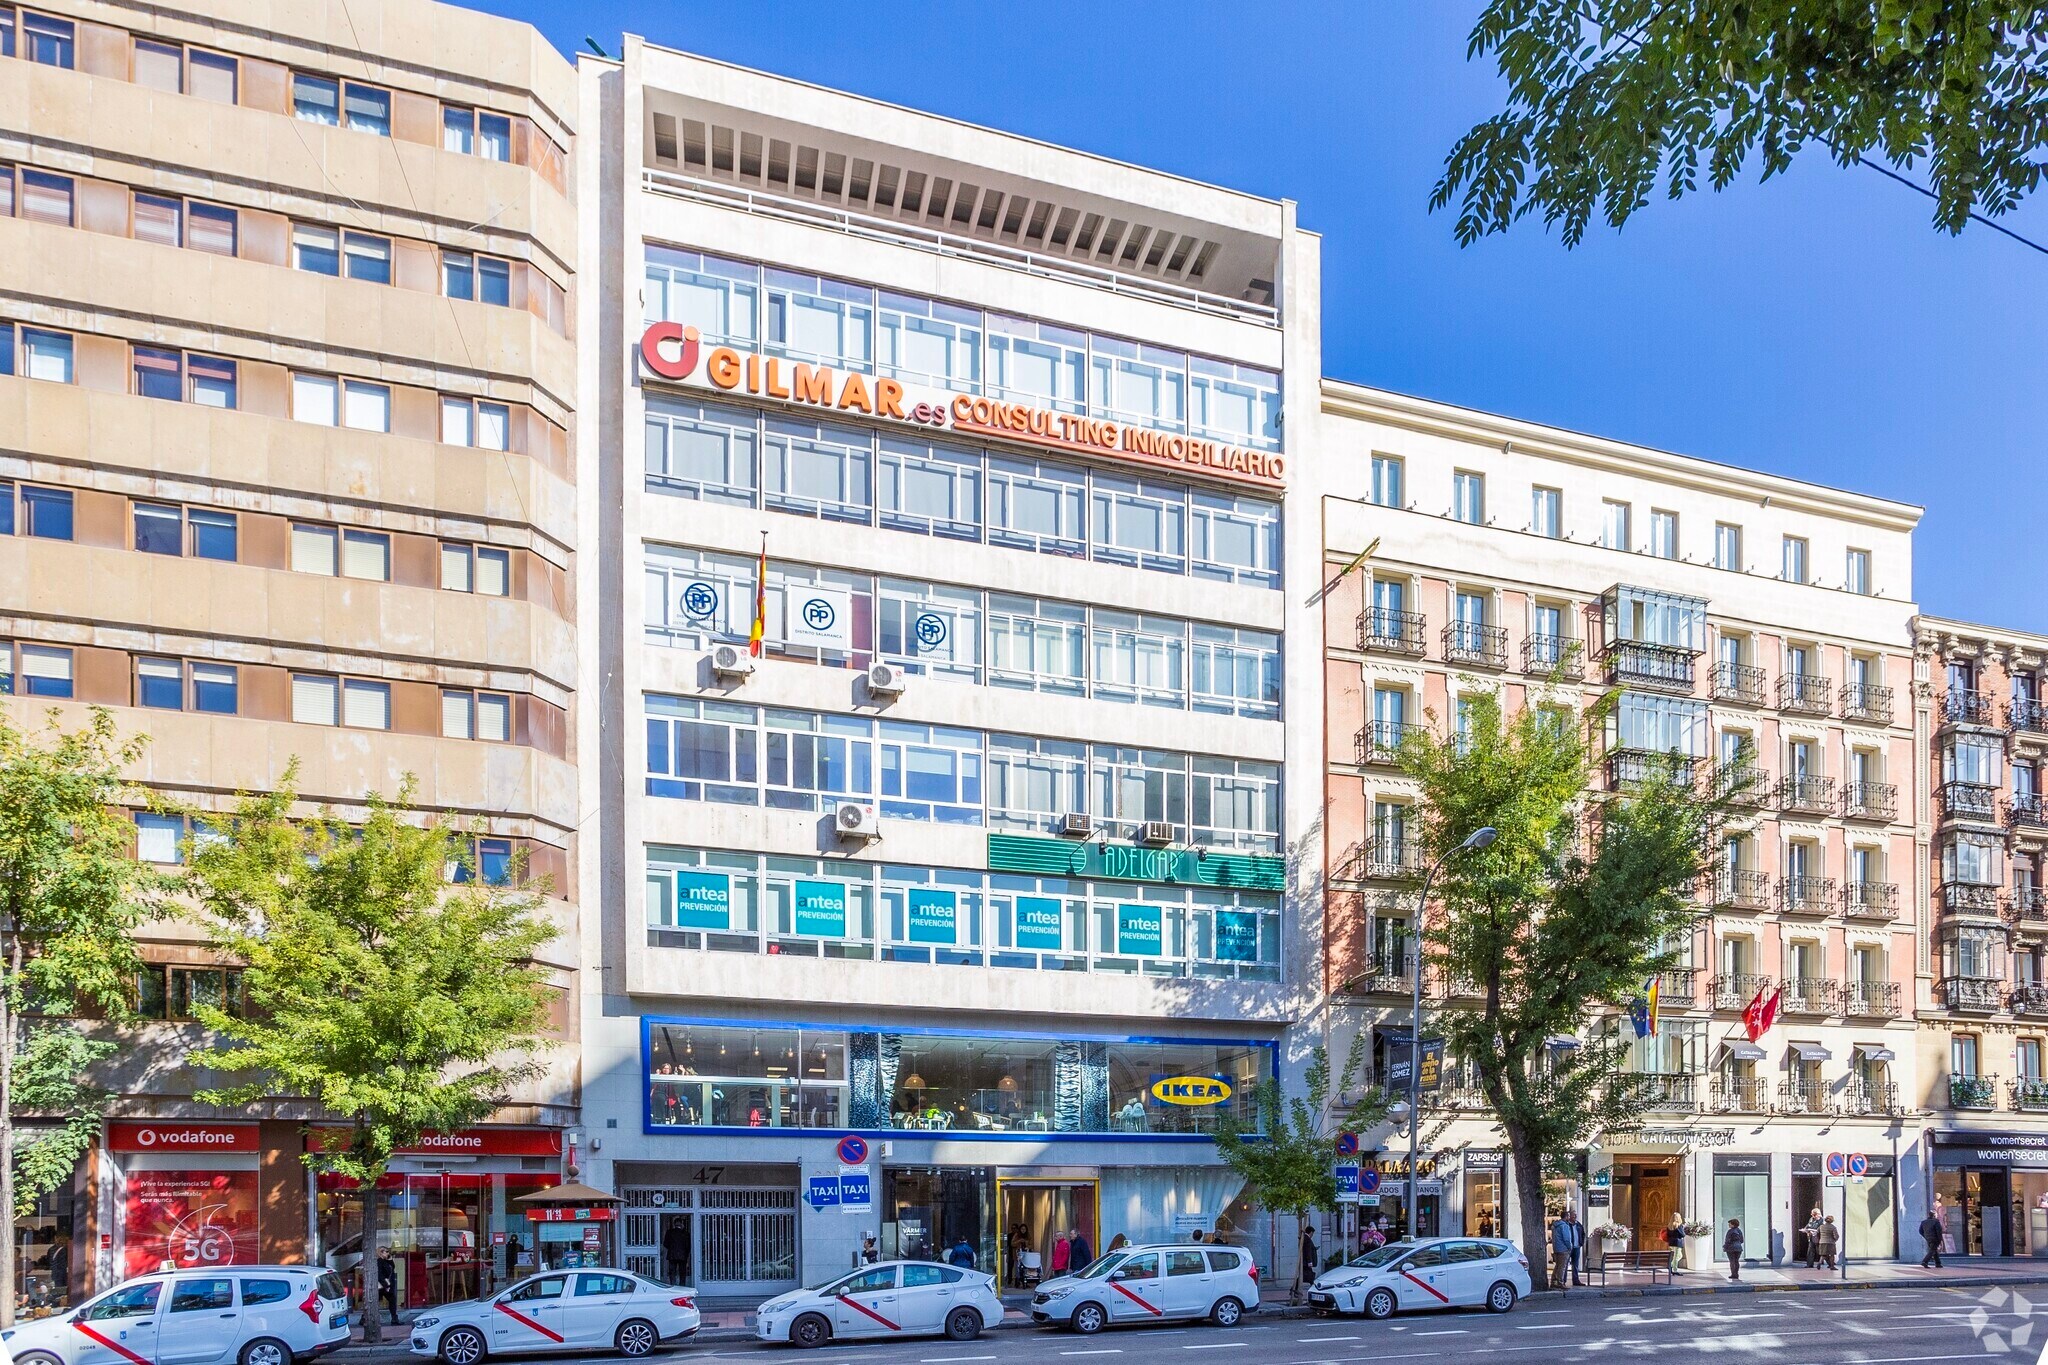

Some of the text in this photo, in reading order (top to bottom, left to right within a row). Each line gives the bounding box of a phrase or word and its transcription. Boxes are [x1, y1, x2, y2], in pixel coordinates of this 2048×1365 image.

[951, 394, 1287, 480] CONSULTING INMOBILIARIO
[692, 592, 712, 608] PP
[809, 608, 829, 624] PP
[922, 623, 940, 638] PP
[680, 885, 728, 902] antea
[680, 901, 728, 913] PREVENCIÓN
[797, 895, 843, 910] antea
[797, 910, 844, 921] PREVENCIÓN
[911, 903, 954, 917] antea
[910, 918, 954, 929] PREVENCIÓN
[1018, 909, 1060, 925] antea
[1018, 925, 1060, 936] PREVENCIÓN
[1120, 917, 1160, 931] antea
[1120, 931, 1160, 942] PREVENCIÓN
[1162, 1084, 1223, 1097] IKEA
[159, 1130, 235, 1144] vodafone
[1990, 1136, 2046, 1146] women'secret
[1977, 1150, 2046, 1160] women'secret
[693, 1166, 725, 1184] 47
[1337, 1175, 1357, 1184] TAXI
[811, 1186, 838, 1196] TAXI
[843, 1184, 868, 1194] TAXI
[183, 1238, 220, 1261] 5G
[300, 1284, 307, 1292] M
